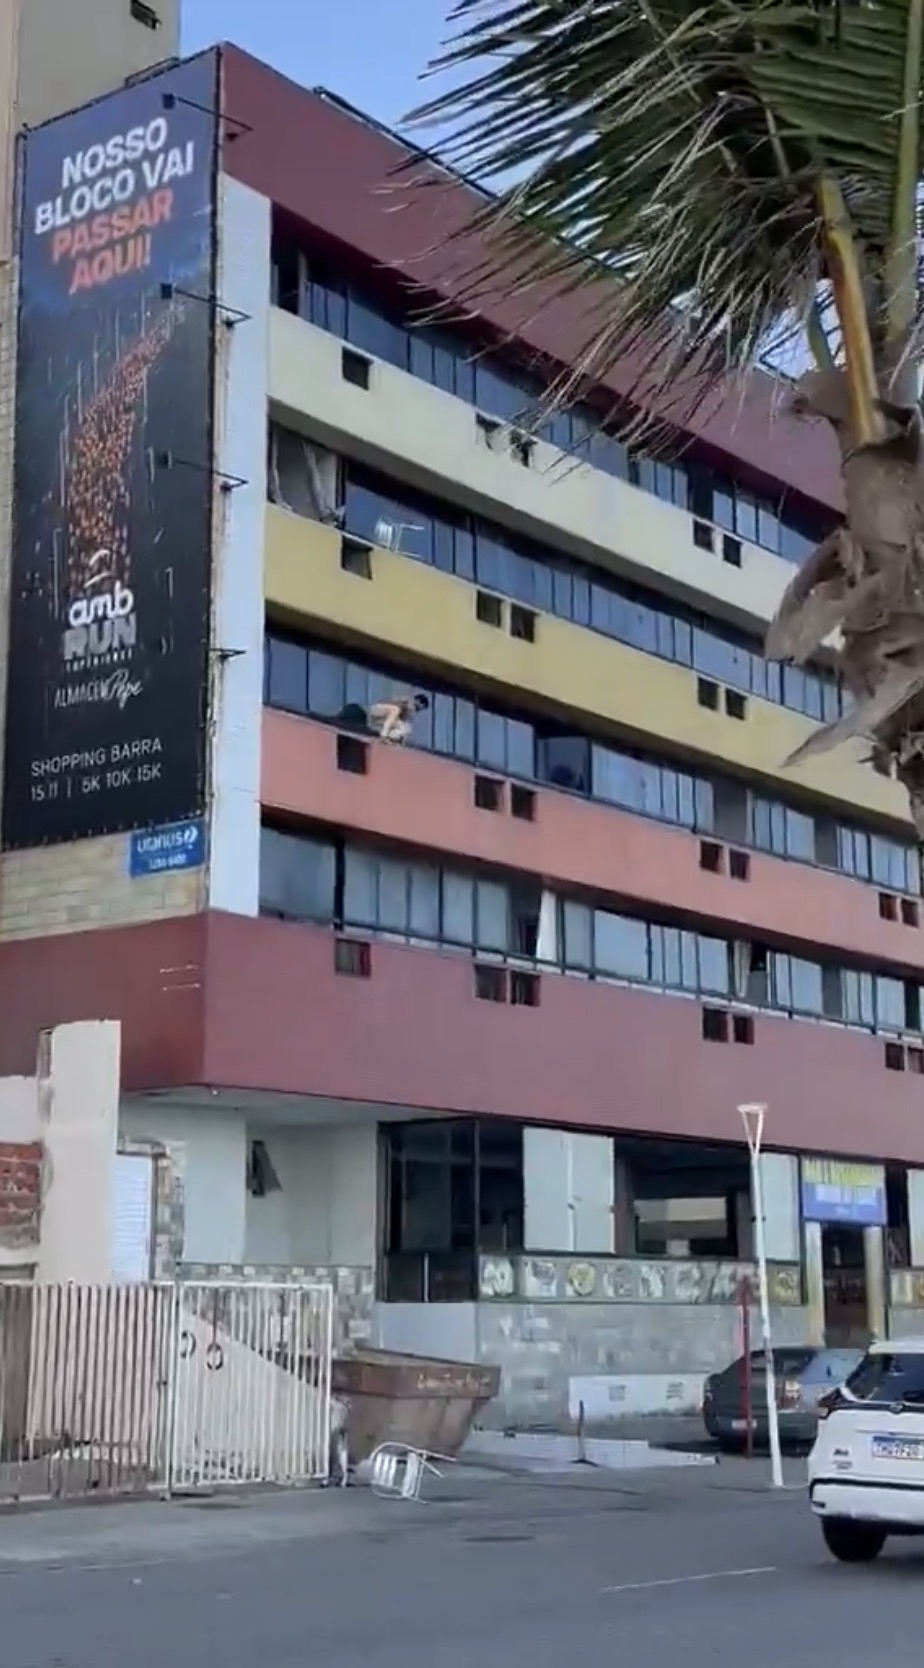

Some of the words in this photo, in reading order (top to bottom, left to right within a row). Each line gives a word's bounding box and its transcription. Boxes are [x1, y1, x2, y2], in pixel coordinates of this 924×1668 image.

[61, 117, 167, 189] NOSSO
[34, 168, 136, 235] BLOCO
[142, 141, 195, 189] VAI
[51, 188, 174, 264] PASSAR
[68, 233, 152, 296] AQUI!
[69, 580, 134, 627] amb
[63, 612, 137, 661] RUN
[31, 748, 106, 777] SHOPPING
[110, 737, 162, 762] BARRA
[82, 775, 101, 793] 5K
[106, 769, 132, 788] 10K
[137, 763, 162, 782] 15K
